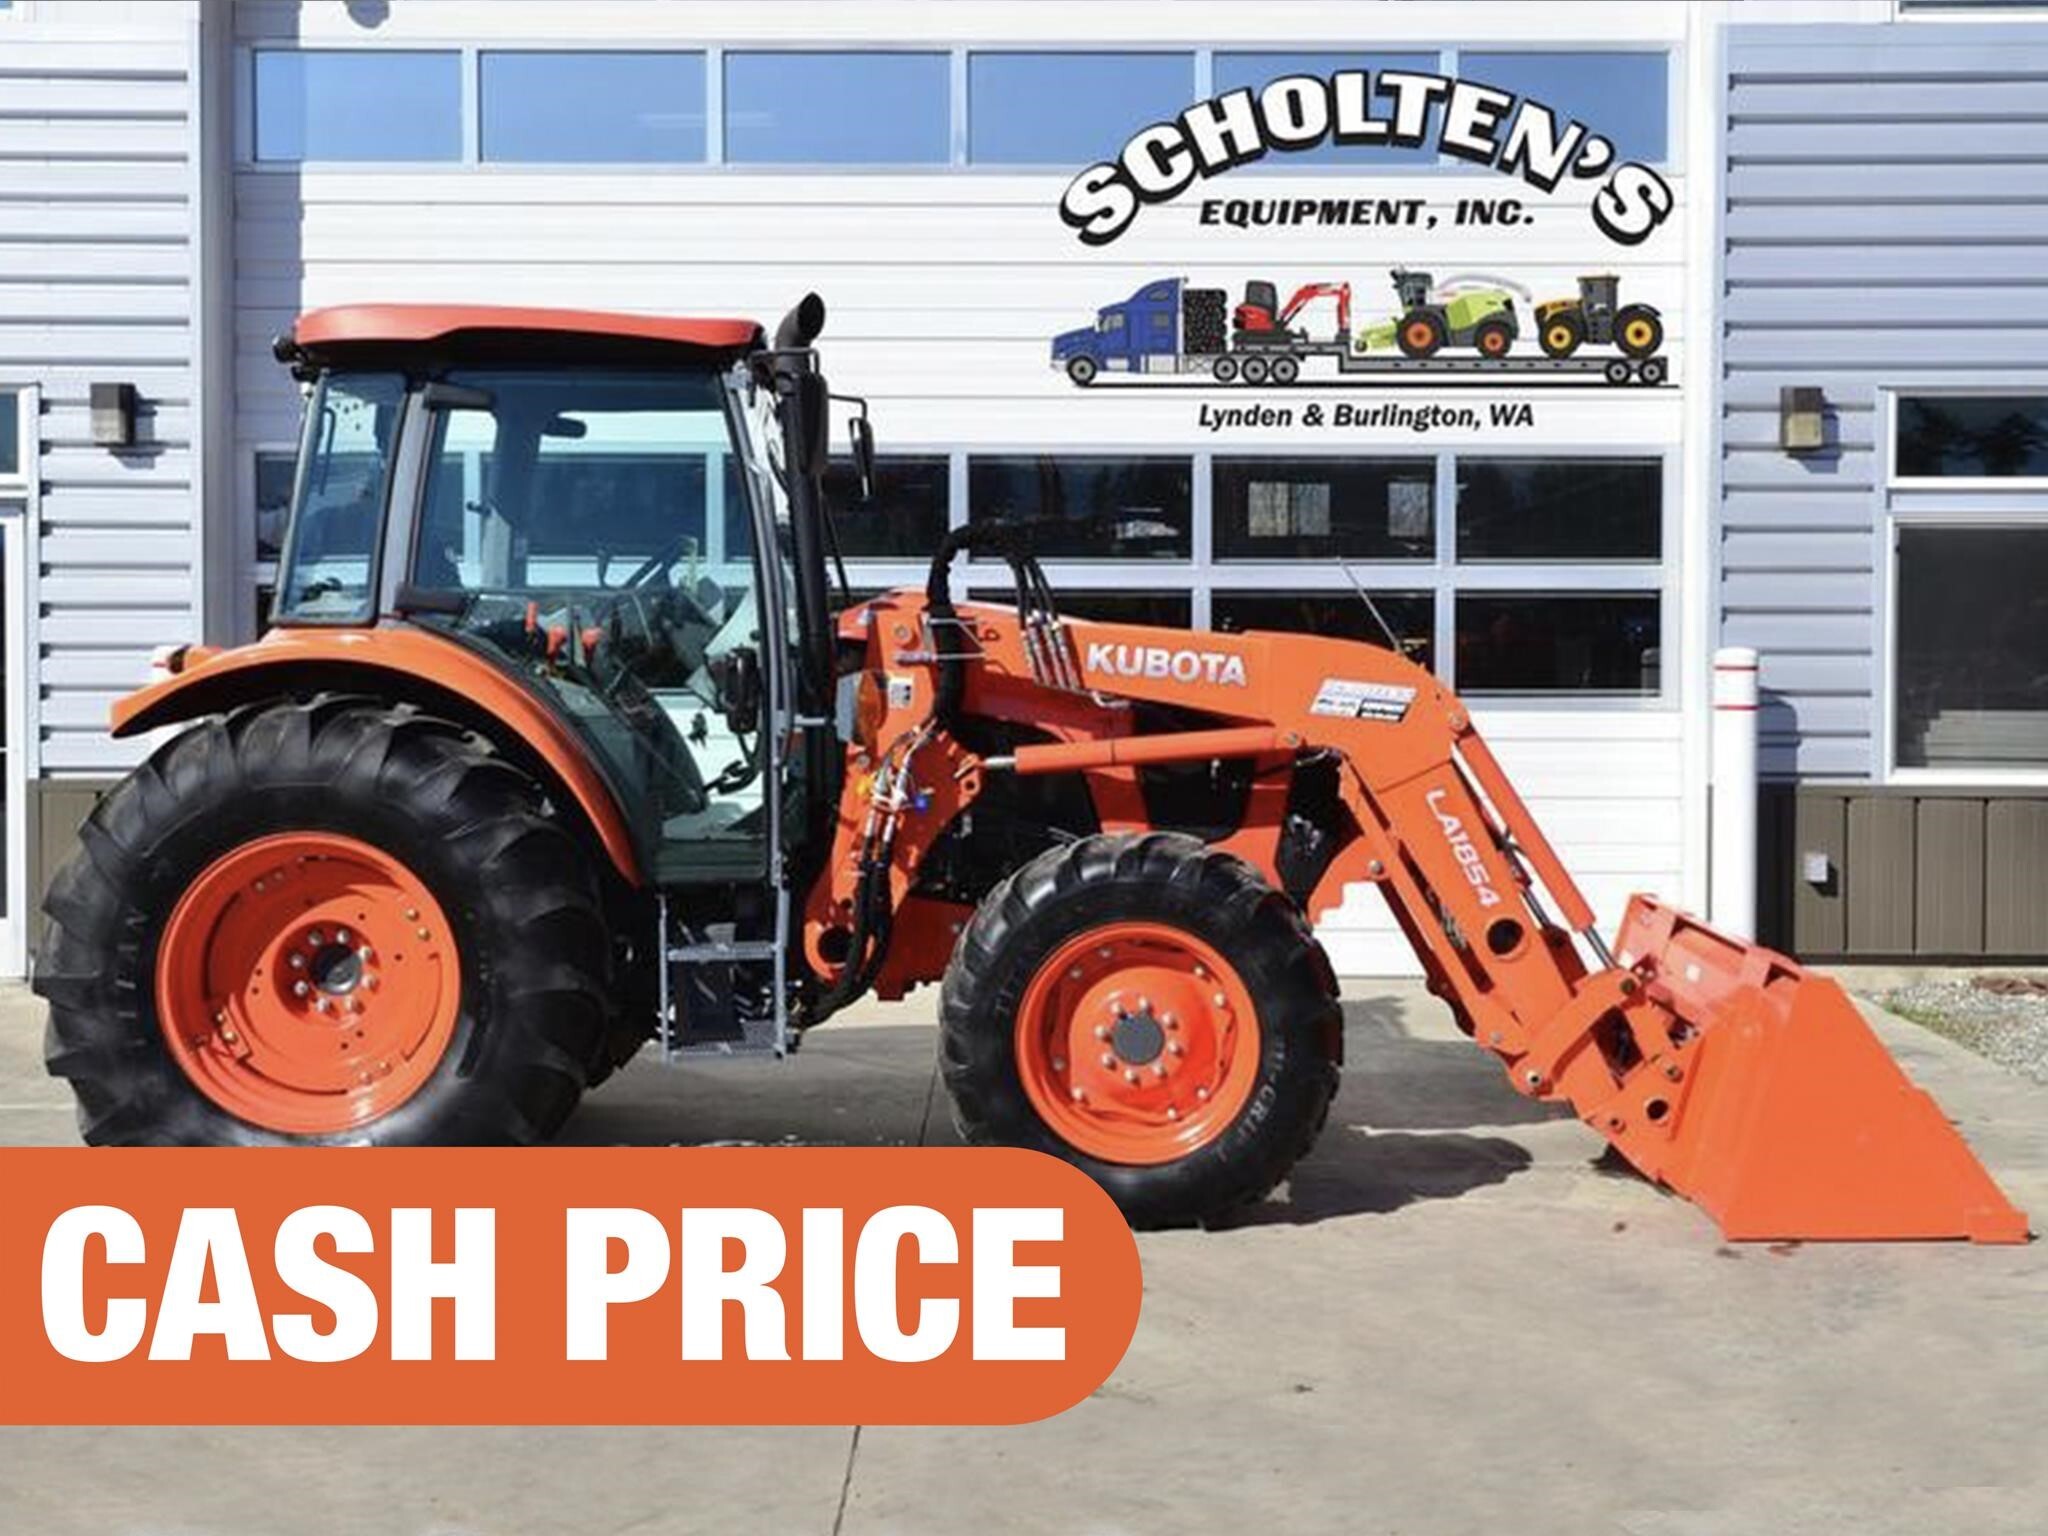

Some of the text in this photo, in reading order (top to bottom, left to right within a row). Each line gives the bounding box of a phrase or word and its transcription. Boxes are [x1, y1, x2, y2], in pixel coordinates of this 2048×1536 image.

[1059, 69, 1674, 246] SCHOLTEN'S
[1199, 199, 1535, 230] EQUIPMENT, INC.
[1198, 403, 1535, 432] Lynden & Burlington, WA
[1086, 642, 1247, 688] KUBOTA
[1425, 787, 1501, 907] LA1854
